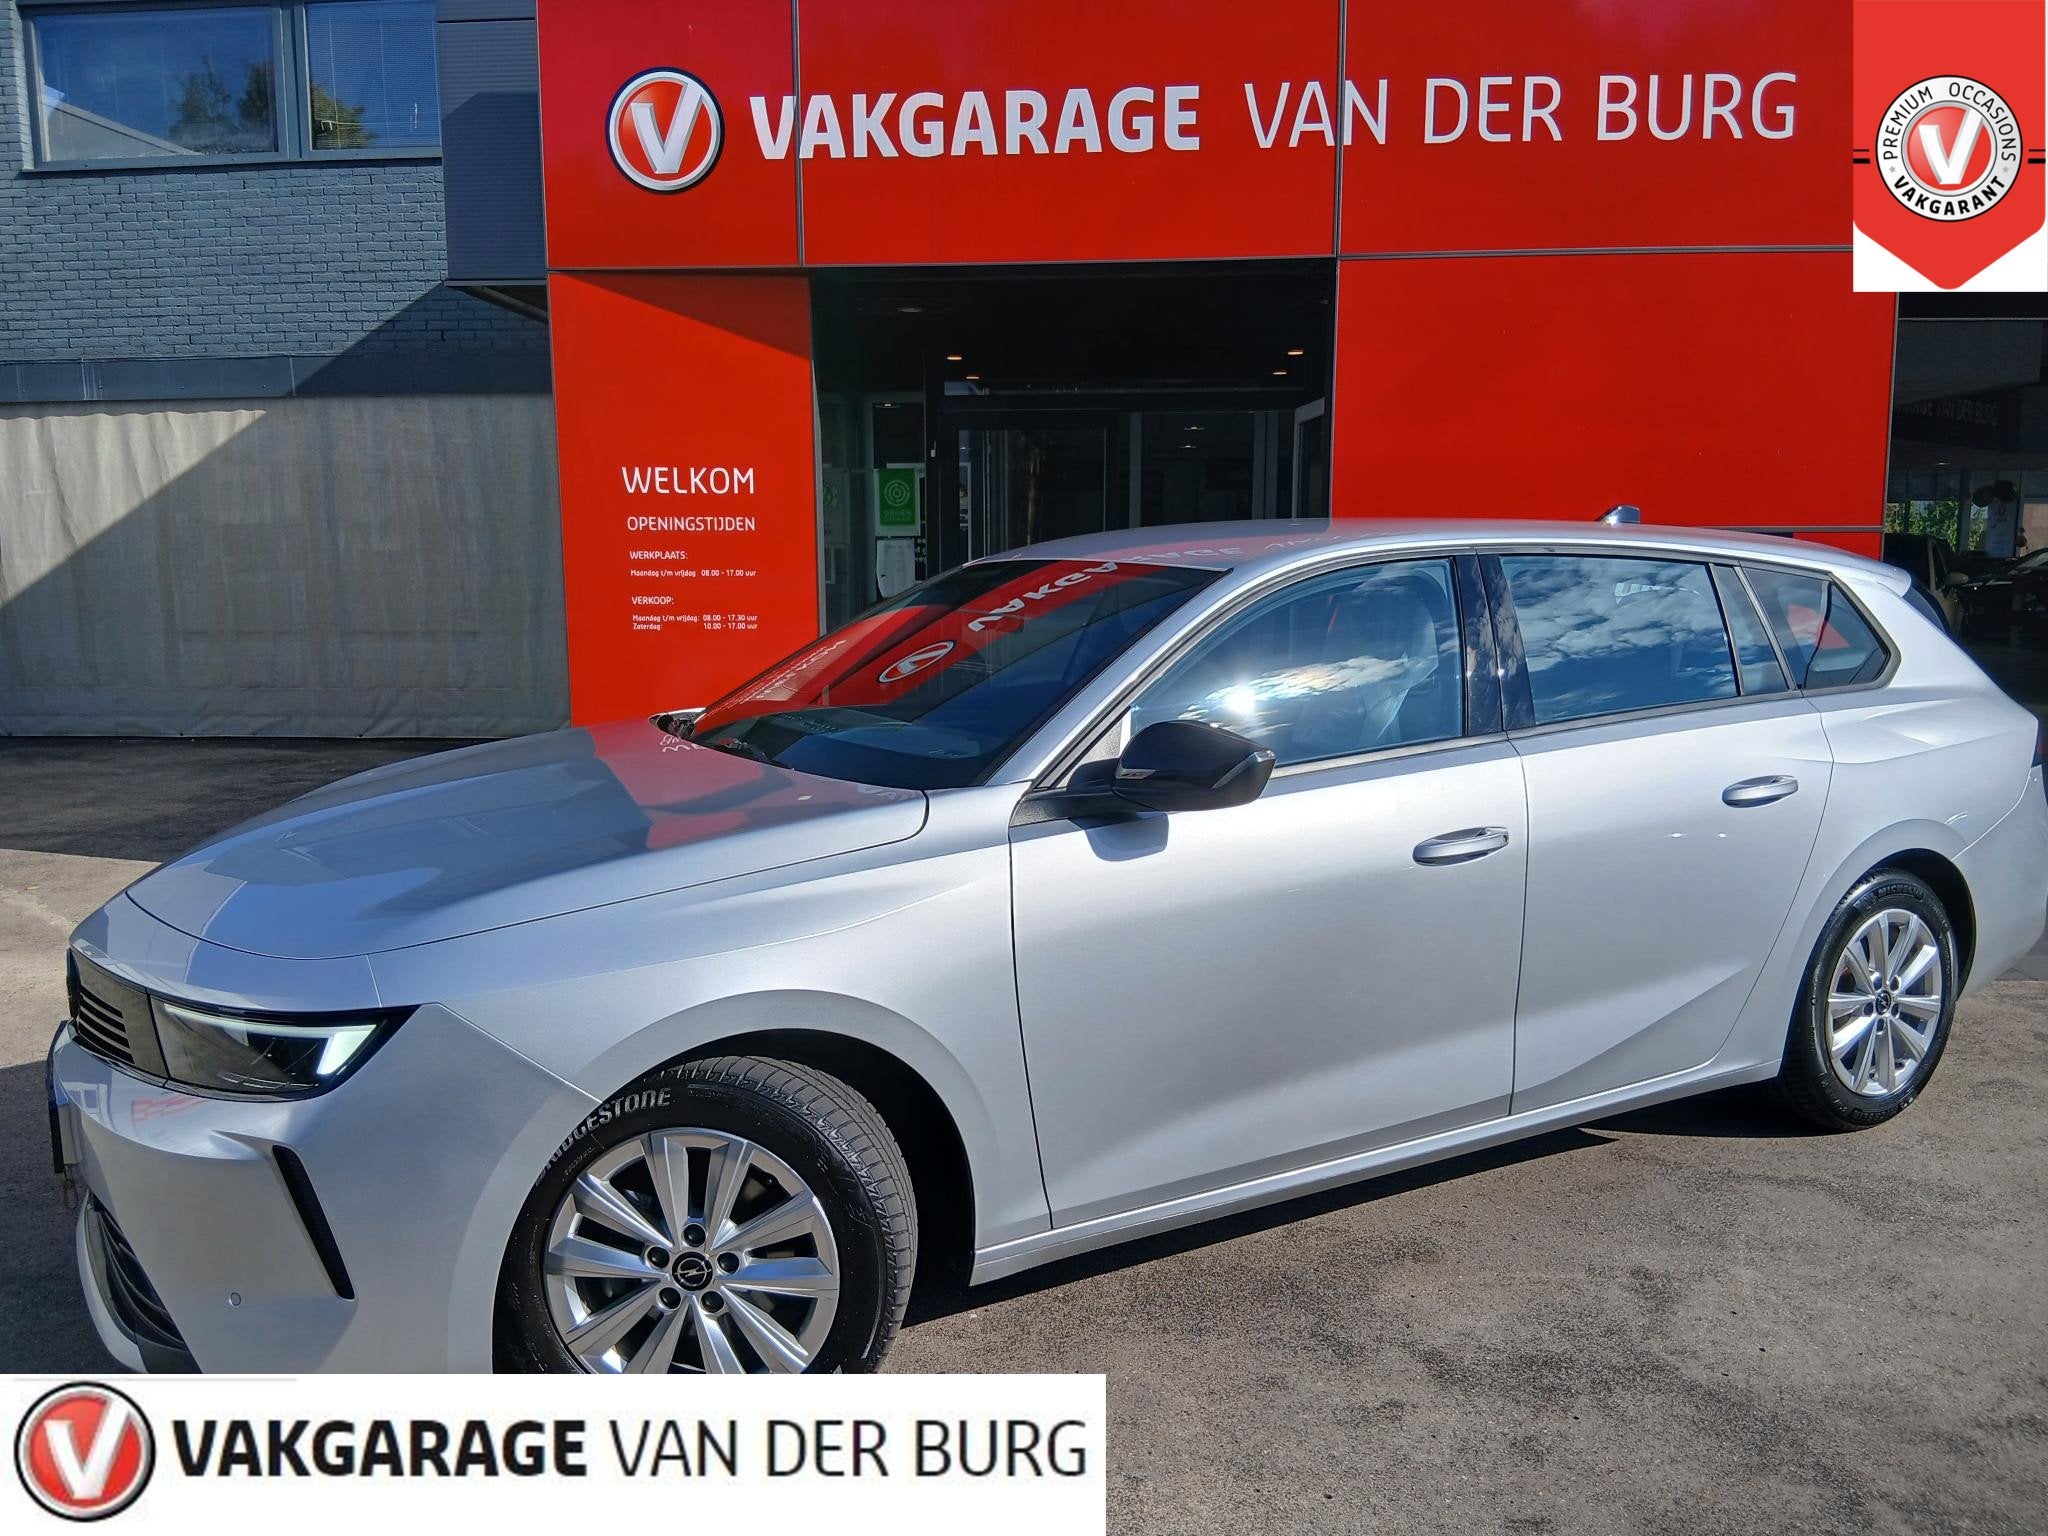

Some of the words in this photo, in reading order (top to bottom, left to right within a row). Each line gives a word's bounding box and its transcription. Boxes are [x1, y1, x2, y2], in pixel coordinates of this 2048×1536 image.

[749, 85, 1200, 161] VAKGARAGE
[1243, 79, 1389, 149] VAN
[1423, 75, 1563, 144] DER
[1597, 71, 1797, 141] BURG
[621, 466, 755, 495] WELKOM
[627, 516, 756, 532] OPENINGSTIJDEN
[629, 550, 689, 560] WERKPLAATS:
[630, 569, 660, 578] Maandag
[660, 569, 674, 577] t/m
[674, 569, 697, 578] vrijdag
[701, 569, 720, 577] 08.00
[726, 569, 744, 577] 17.00
[631, 596, 675, 605] VERKOOP:
[632, 614, 661, 623] Maandag
[662, 614, 675, 622] t/m
[676, 614, 700, 623] vrijdag:
[702, 614, 721, 622] 08.00
[727, 614, 746, 622] 17.30
[633, 622, 663, 631] Zaterdag:
[703, 622, 722, 630] 10.00
[728, 622, 746, 630] 17.00
